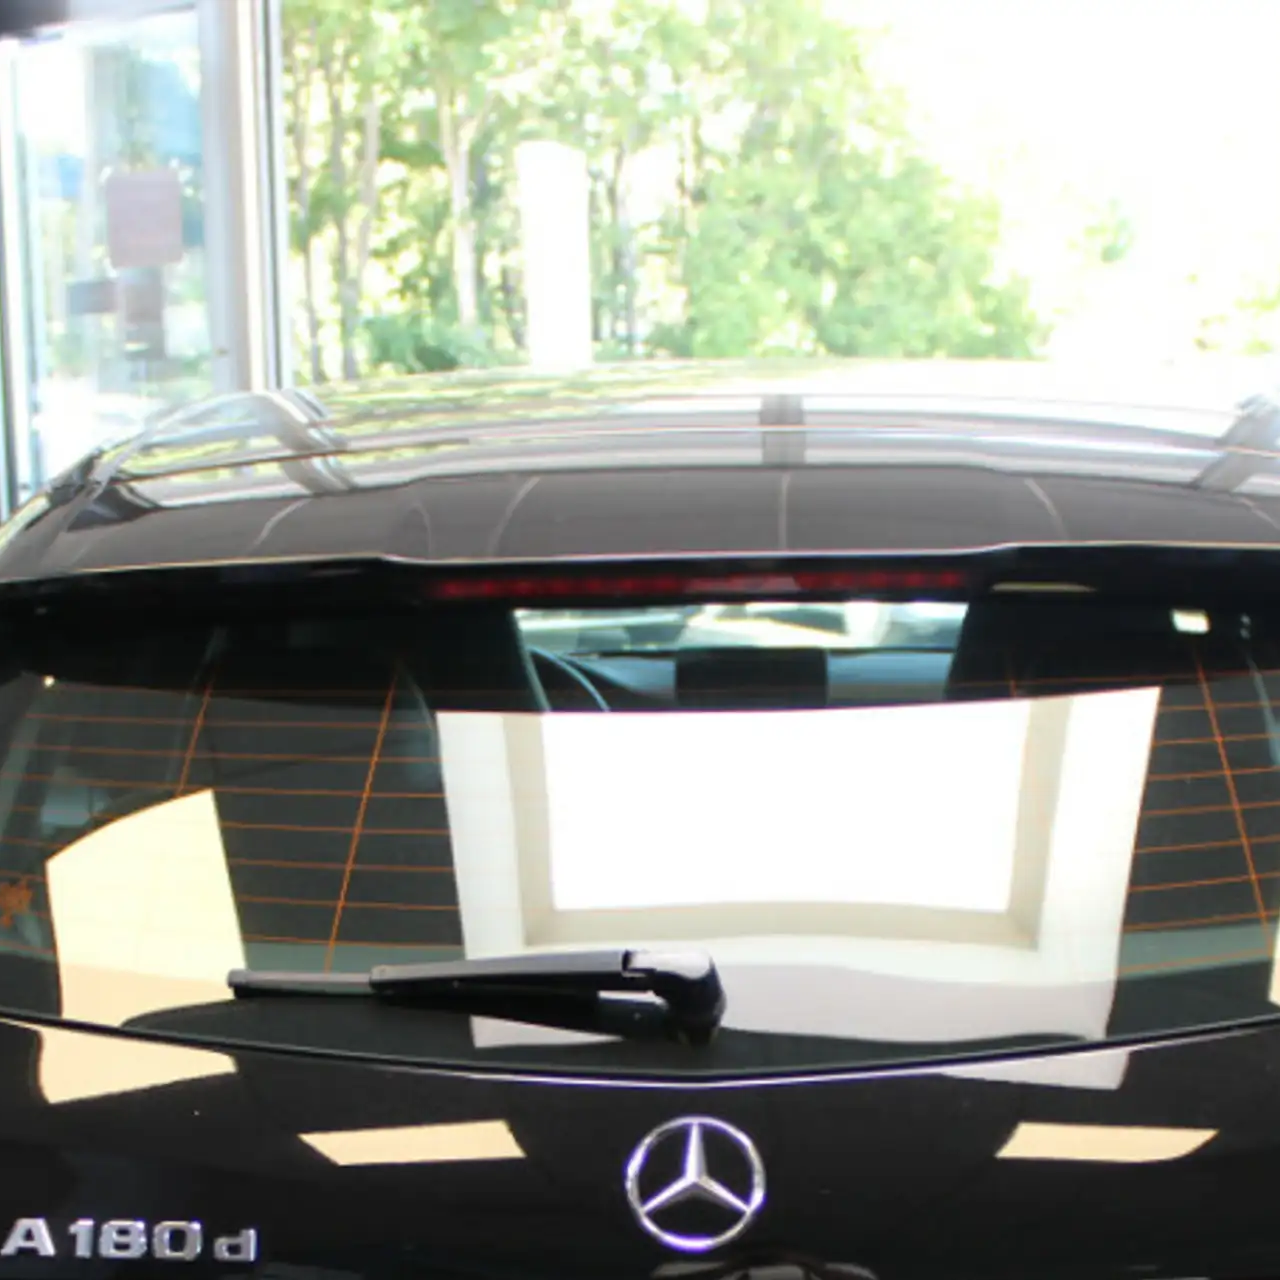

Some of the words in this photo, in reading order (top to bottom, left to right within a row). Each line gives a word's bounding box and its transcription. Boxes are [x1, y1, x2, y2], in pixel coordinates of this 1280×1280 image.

[0, 1217, 56, 1257] A
[68, 1218, 204, 1261] 180
[213, 1228, 257, 1263] d
